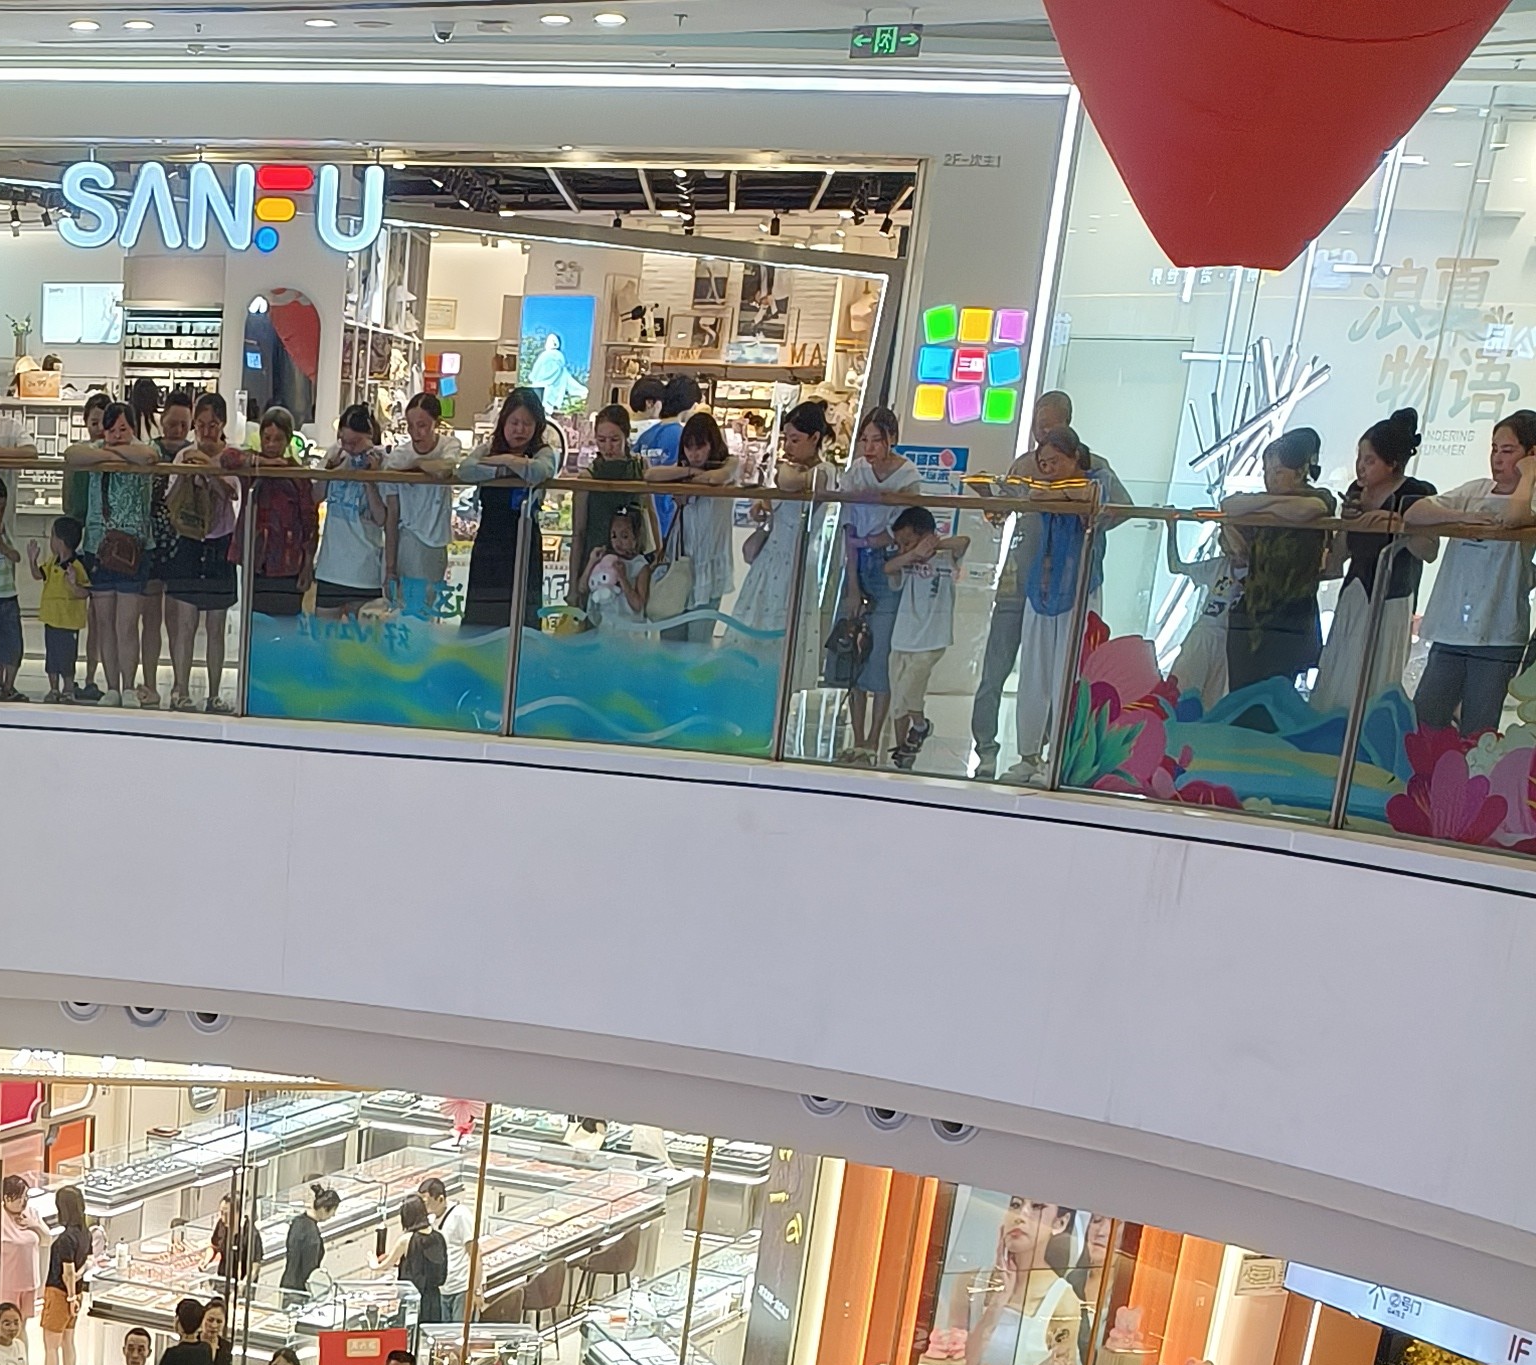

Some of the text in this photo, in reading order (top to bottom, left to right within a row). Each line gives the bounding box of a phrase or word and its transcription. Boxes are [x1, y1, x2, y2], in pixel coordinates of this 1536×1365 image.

[57, 160, 386, 253] SANFU
[1347, 257, 1500, 342] 浪夏
[1376, 344, 1521, 424] 物语
